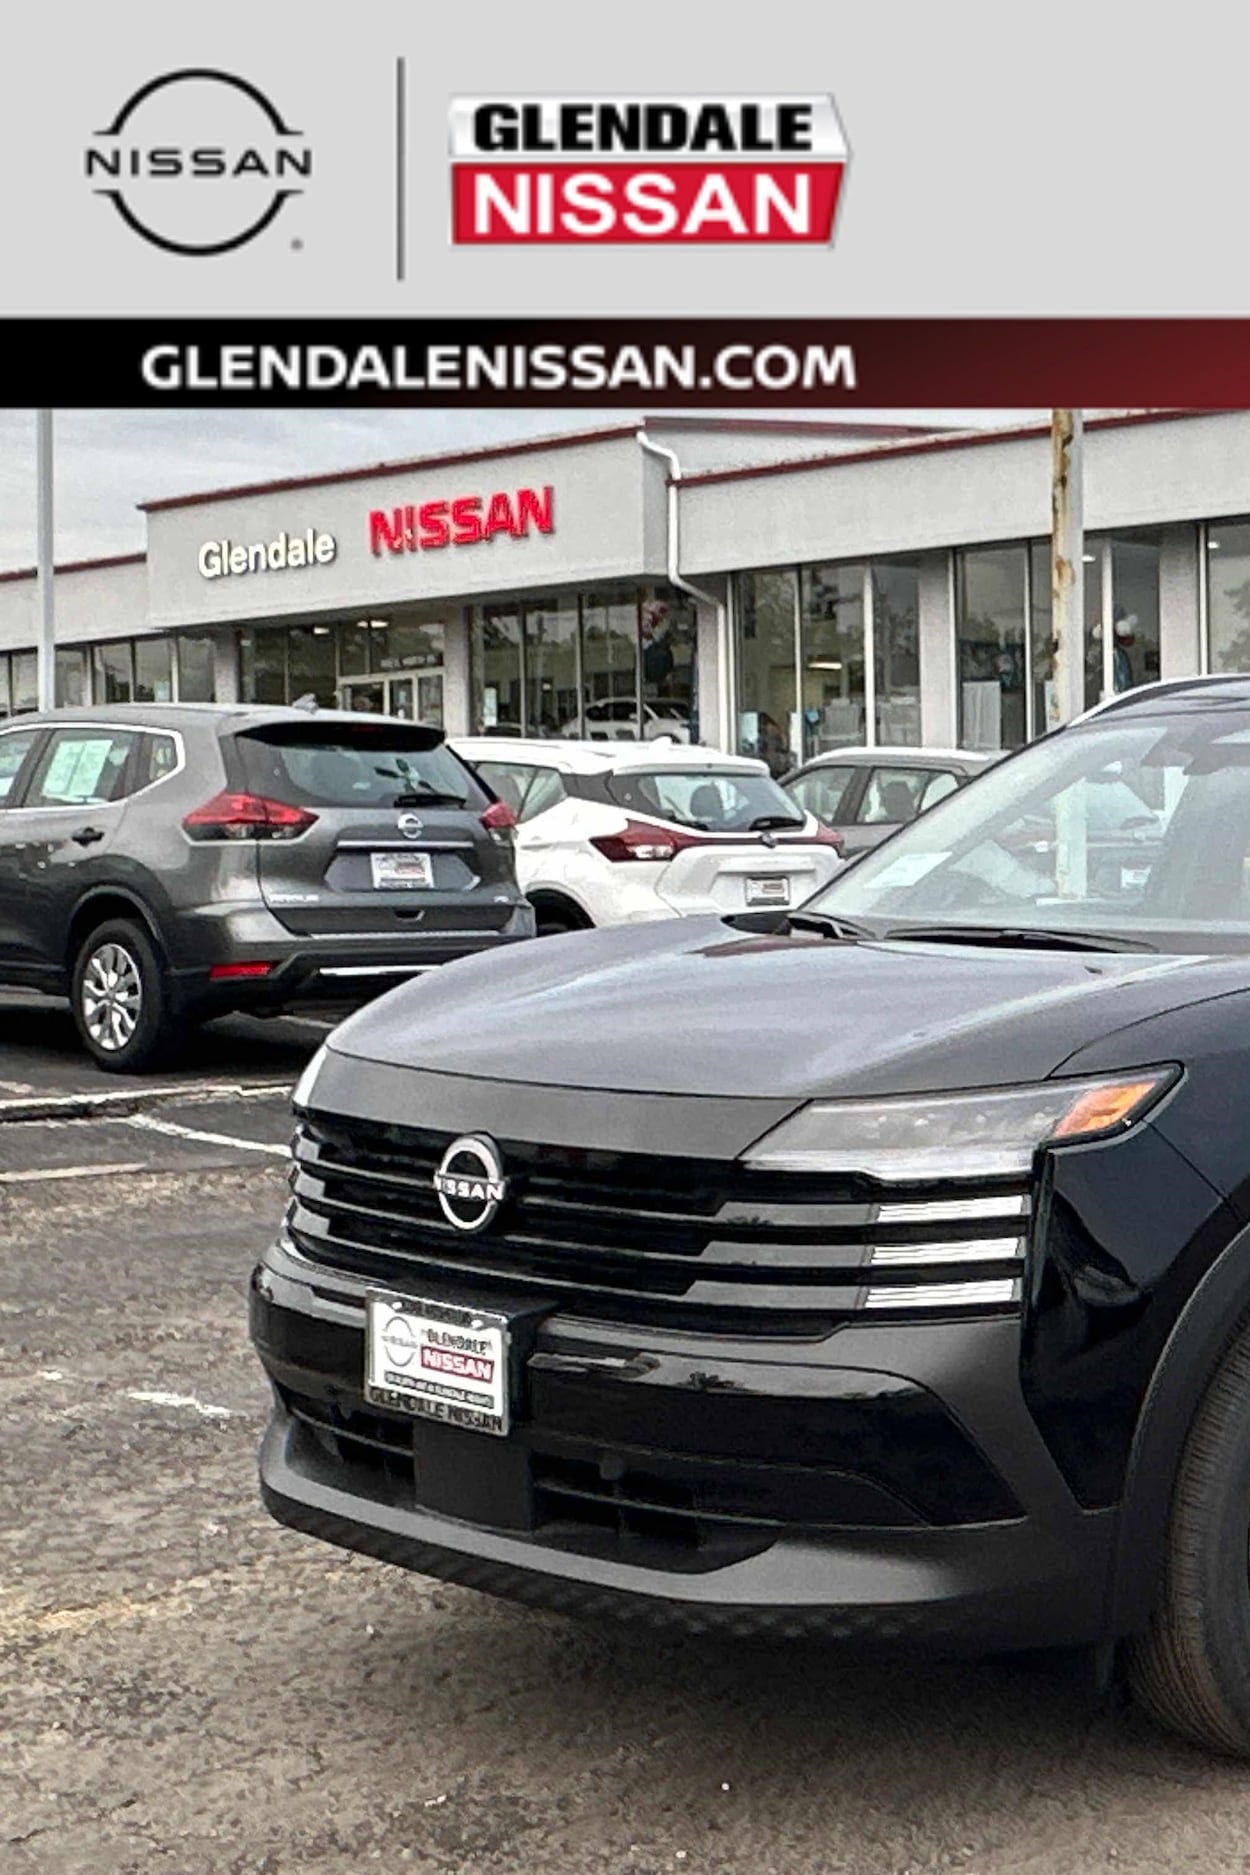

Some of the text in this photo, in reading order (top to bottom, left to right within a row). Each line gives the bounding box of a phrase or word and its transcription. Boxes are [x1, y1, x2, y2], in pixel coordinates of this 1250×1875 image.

[198, 486, 554, 578] Glendale NISSAN
[423, 1350, 492, 1380] NISSAN
